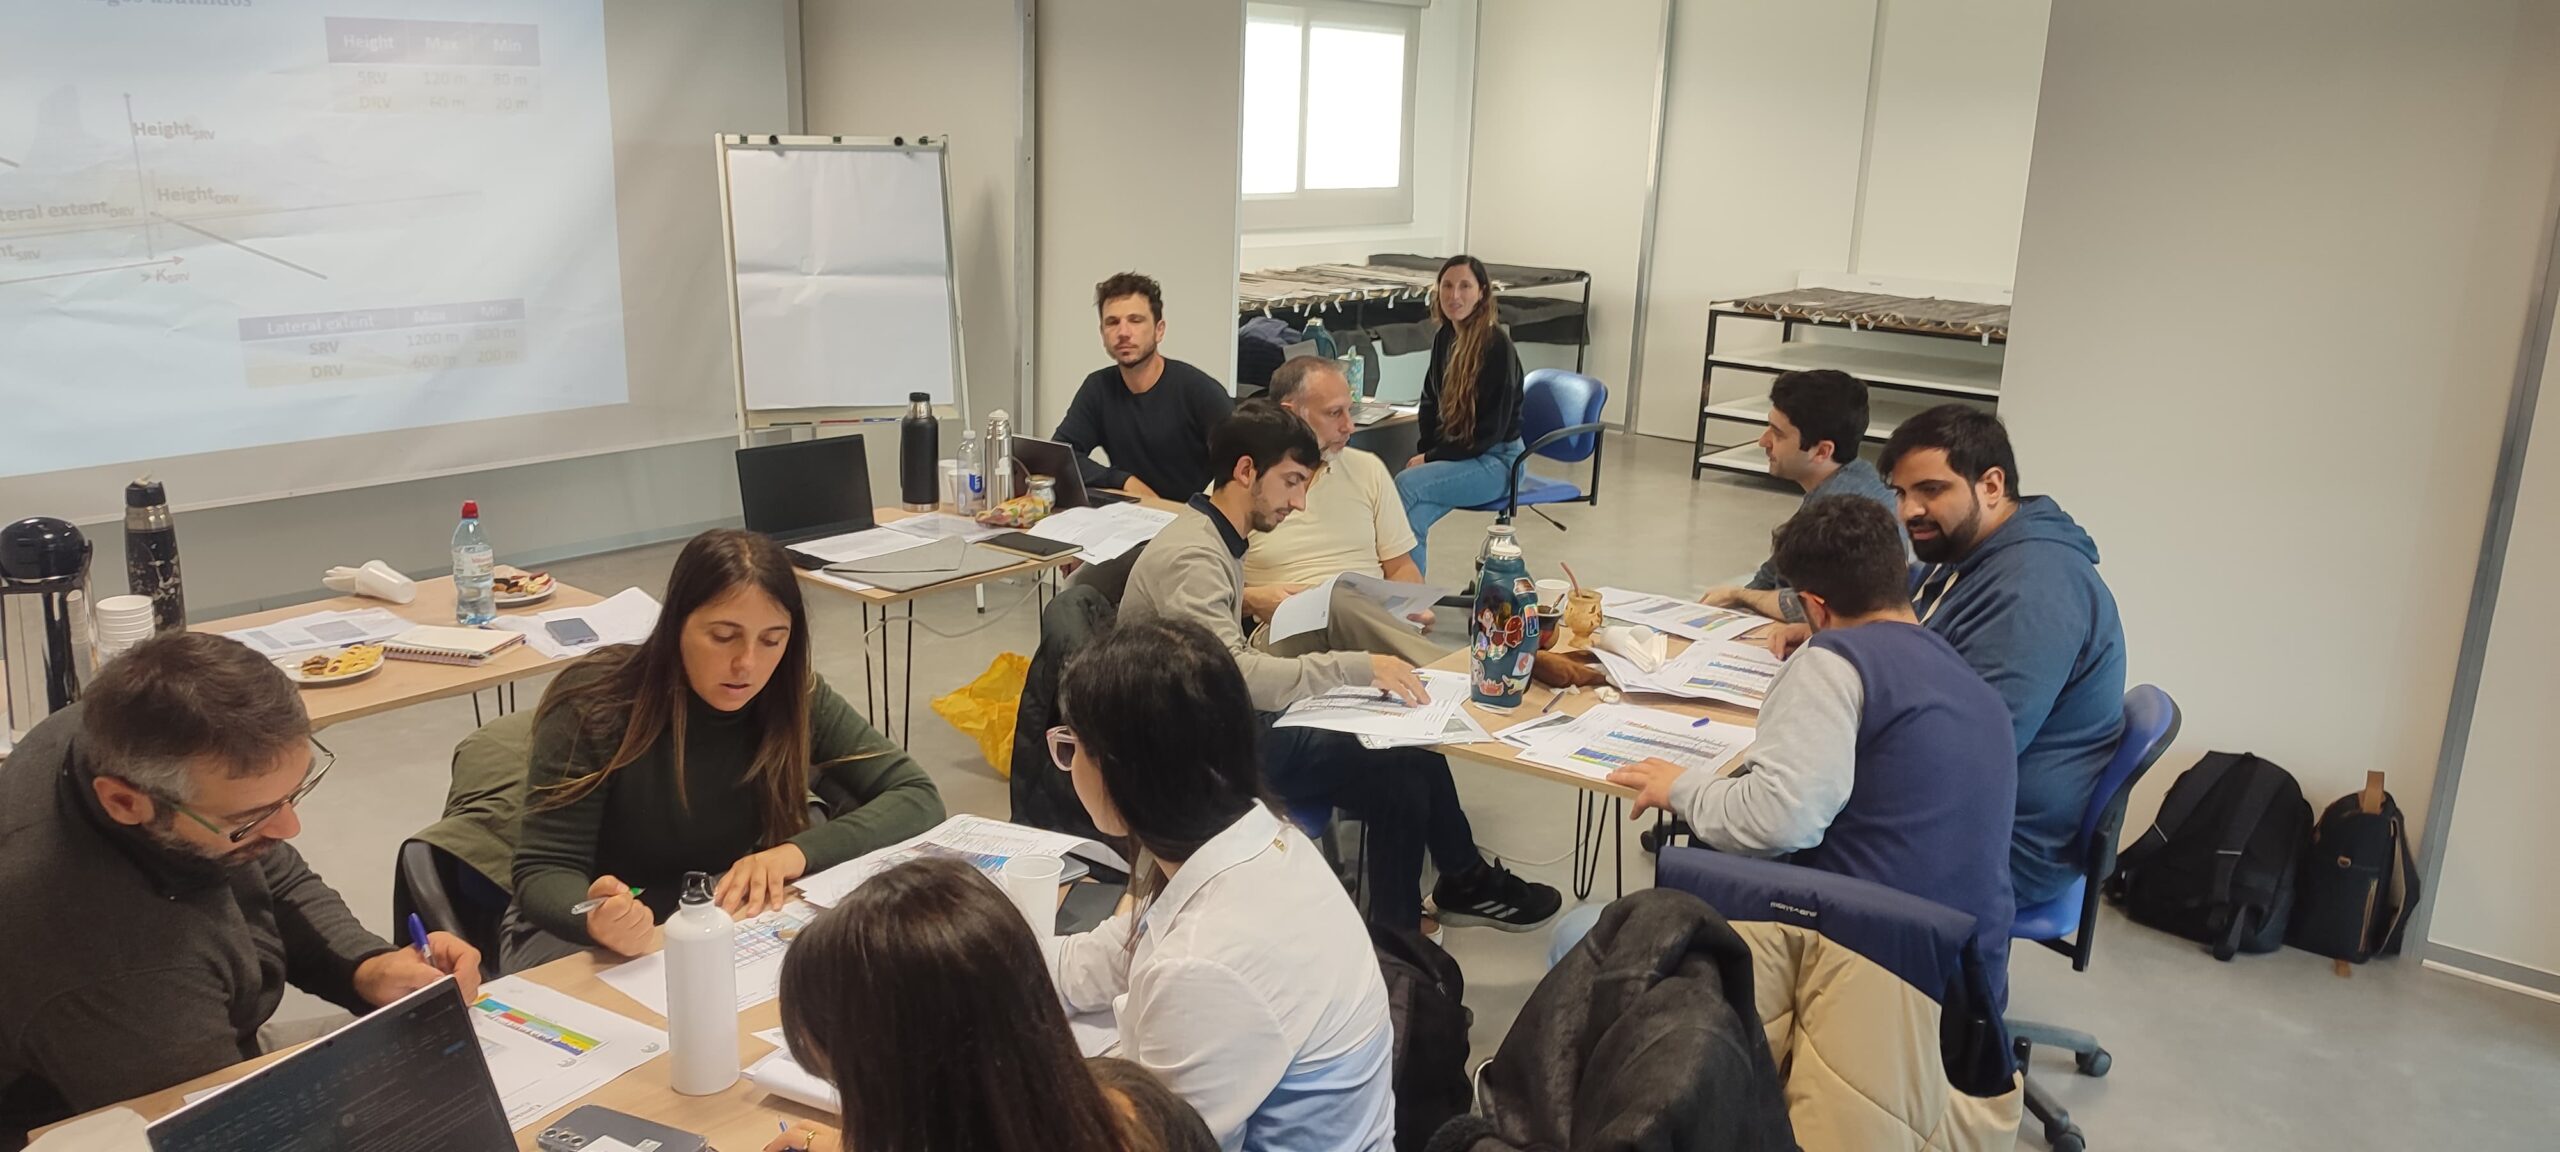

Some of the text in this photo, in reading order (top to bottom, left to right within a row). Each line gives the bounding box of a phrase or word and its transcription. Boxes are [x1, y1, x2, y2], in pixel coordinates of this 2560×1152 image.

[343, 34, 523, 52] Height Max Min
[357, 71, 388, 85] SRV
[359, 96, 392, 110] DRV
[267, 317, 322, 335] Lateral
[326, 313, 376, 332] extent
[309, 340, 341, 356] SRV
[407, 332, 442, 347] 1200
[311, 364, 345, 380] DRV
